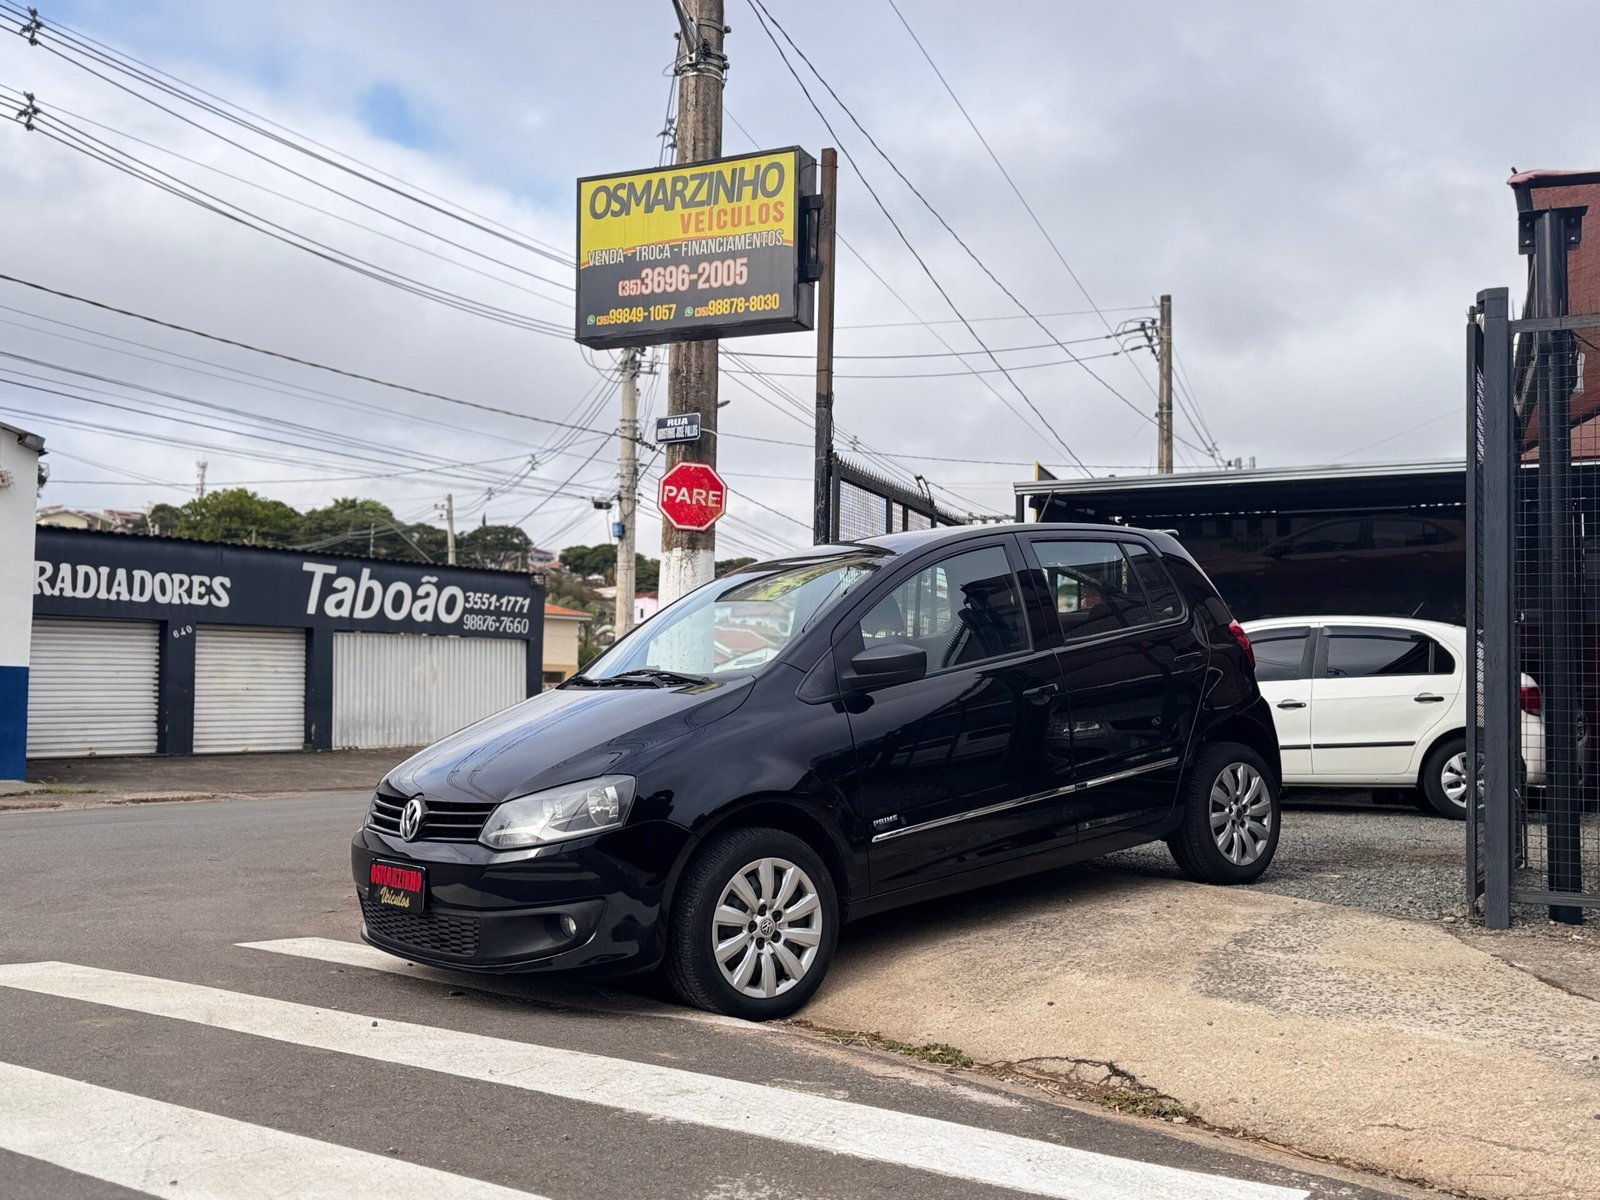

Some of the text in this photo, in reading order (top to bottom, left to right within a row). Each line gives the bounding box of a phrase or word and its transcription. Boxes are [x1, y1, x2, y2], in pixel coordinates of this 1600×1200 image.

[589, 161, 785, 220] OSMARZINHO
[680, 200, 785, 234] VEÍCULOS
[588, 248, 624, 267] VENDA
[635, 243, 671, 262] TROCA
[681, 229, 783, 256] FINANCIAMENTOS
[618, 257, 748, 297] (35)3696-2005
[667, 417, 688, 426] RUA
[663, 485, 722, 508] PARE
[34, 560, 232, 608] RADIADORES
[302, 561, 465, 624] Taboão
[172, 624, 193, 639] 640
[872, 814, 898, 828] PRIME
